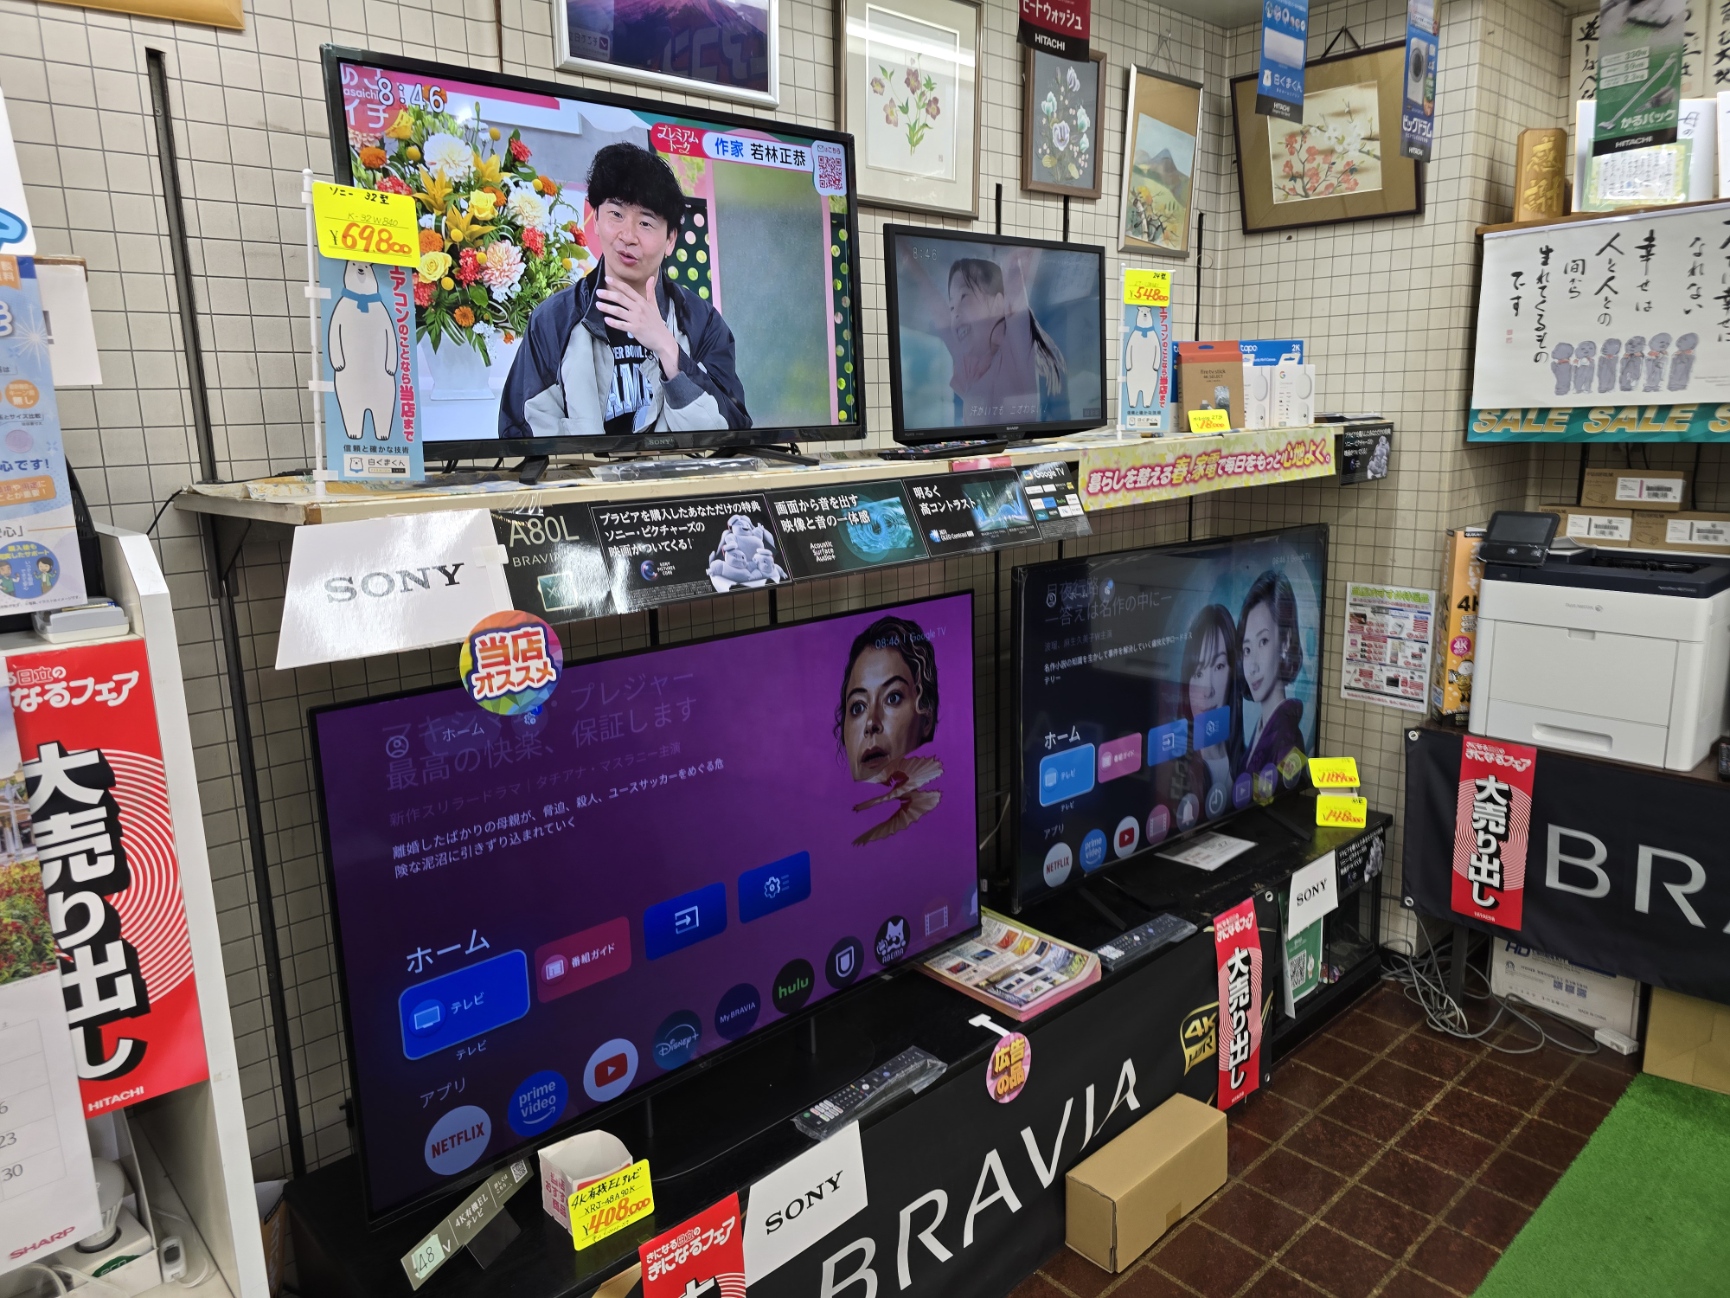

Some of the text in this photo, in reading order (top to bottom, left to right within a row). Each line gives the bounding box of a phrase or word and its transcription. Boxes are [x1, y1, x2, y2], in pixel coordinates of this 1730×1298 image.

[1034, 33, 1065, 51] HITACHI
[377, 77, 445, 113] 8:46
[657, 125, 699, 143] プレミアム
[1402, 115, 1432, 138] ビッグドラム
[669, 139, 691, 155] トーク
[714, 137, 806, 167] 作家 若林正恭
[1615, 136, 1653, 148] HITACHI
[912, 247, 938, 260] 8:46
[1563, 259, 1586, 299] 間から
[1594, 232, 1624, 327] 人と人との
[1635, 229, 1657, 312] 幸せは
[1510, 271, 1526, 317] です
[1240, 344, 1258, 353] tapo
[1472, 407, 1572, 434] SALE
[1583, 402, 1699, 434] SALE
[343, 444, 410, 455] 信頼と確かな技術
[1034, 468, 1066, 480] Google TV
[912, 485, 942, 500] 明るく
[600, 501, 761, 526] ブラビアを購入したあなただけの特典
[774, 494, 858, 516] 画面から音を出す
[918, 497, 977, 517] 高コントラスト
[509, 515, 580, 547] A80L
[604, 521, 705, 542] ソニー・ピクチャーズの
[780, 510, 870, 534] 映像と音の一体感
[809, 541, 833, 550] Acoustic
[812, 548, 834, 556] Surface
[324, 563, 465, 604] SONY
[477, 628, 545, 671] 当店
[875, 626, 947, 650] 08:46 Google TV
[474, 660, 554, 698] オススメ
[1044, 675, 1062, 686] テリー
[441, 722, 485, 743] ホーム
[1044, 726, 1080, 750] ホーム
[1060, 769, 1076, 780] テレビ
[1060, 801, 1075, 812] テレビ
[1043, 823, 1064, 839] アプリ
[1467, 774, 1510, 908] 大売り出し
[394, 816, 576, 879] 険な泥沼に引きずり込まれていく
[1084, 838, 1103, 851] prime
[1046, 857, 1070, 874] NETFLIX
[1545, 823, 1730, 934] BR
[1296, 878, 1328, 907] SONY
[22, 741, 137, 1079] 大売り出し
[406, 929, 490, 974] ホーム
[571, 942, 616, 969] 番組ガイド
[882, 947, 904, 964] ABEMA
[778, 976, 809, 999] hulu
[450, 991, 485, 1015] テレビ
[719, 1001, 756, 1025] My BRAVIA
[1185, 1011, 1217, 1039] 4K
[1228, 947, 1250, 1090] 大売り出し
[455, 1039, 488, 1061] テレビ
[992, 1037, 1025, 1076] 広告
[996, 1063, 1025, 1098] の品
[88, 1085, 145, 1112] HITACHI
[420, 1077, 467, 1109] アプリ
[519, 1081, 557, 1106] prime
[520, 1094, 557, 1118] video
[431, 1121, 486, 1160] NETFLIX
[1, 1163, 24, 1182] 30
[820, 1058, 1141, 1298] BRAVIA
[455, 1193, 489, 1227] 4K有機EL
[766, 1170, 843, 1236] SONY
[465, 1208, 484, 1229] テレビ
[9, 1226, 76, 1260] SHARP
[646, 1226, 701, 1264] きになる日立の
[648, 1216, 736, 1281] きになるフェア
